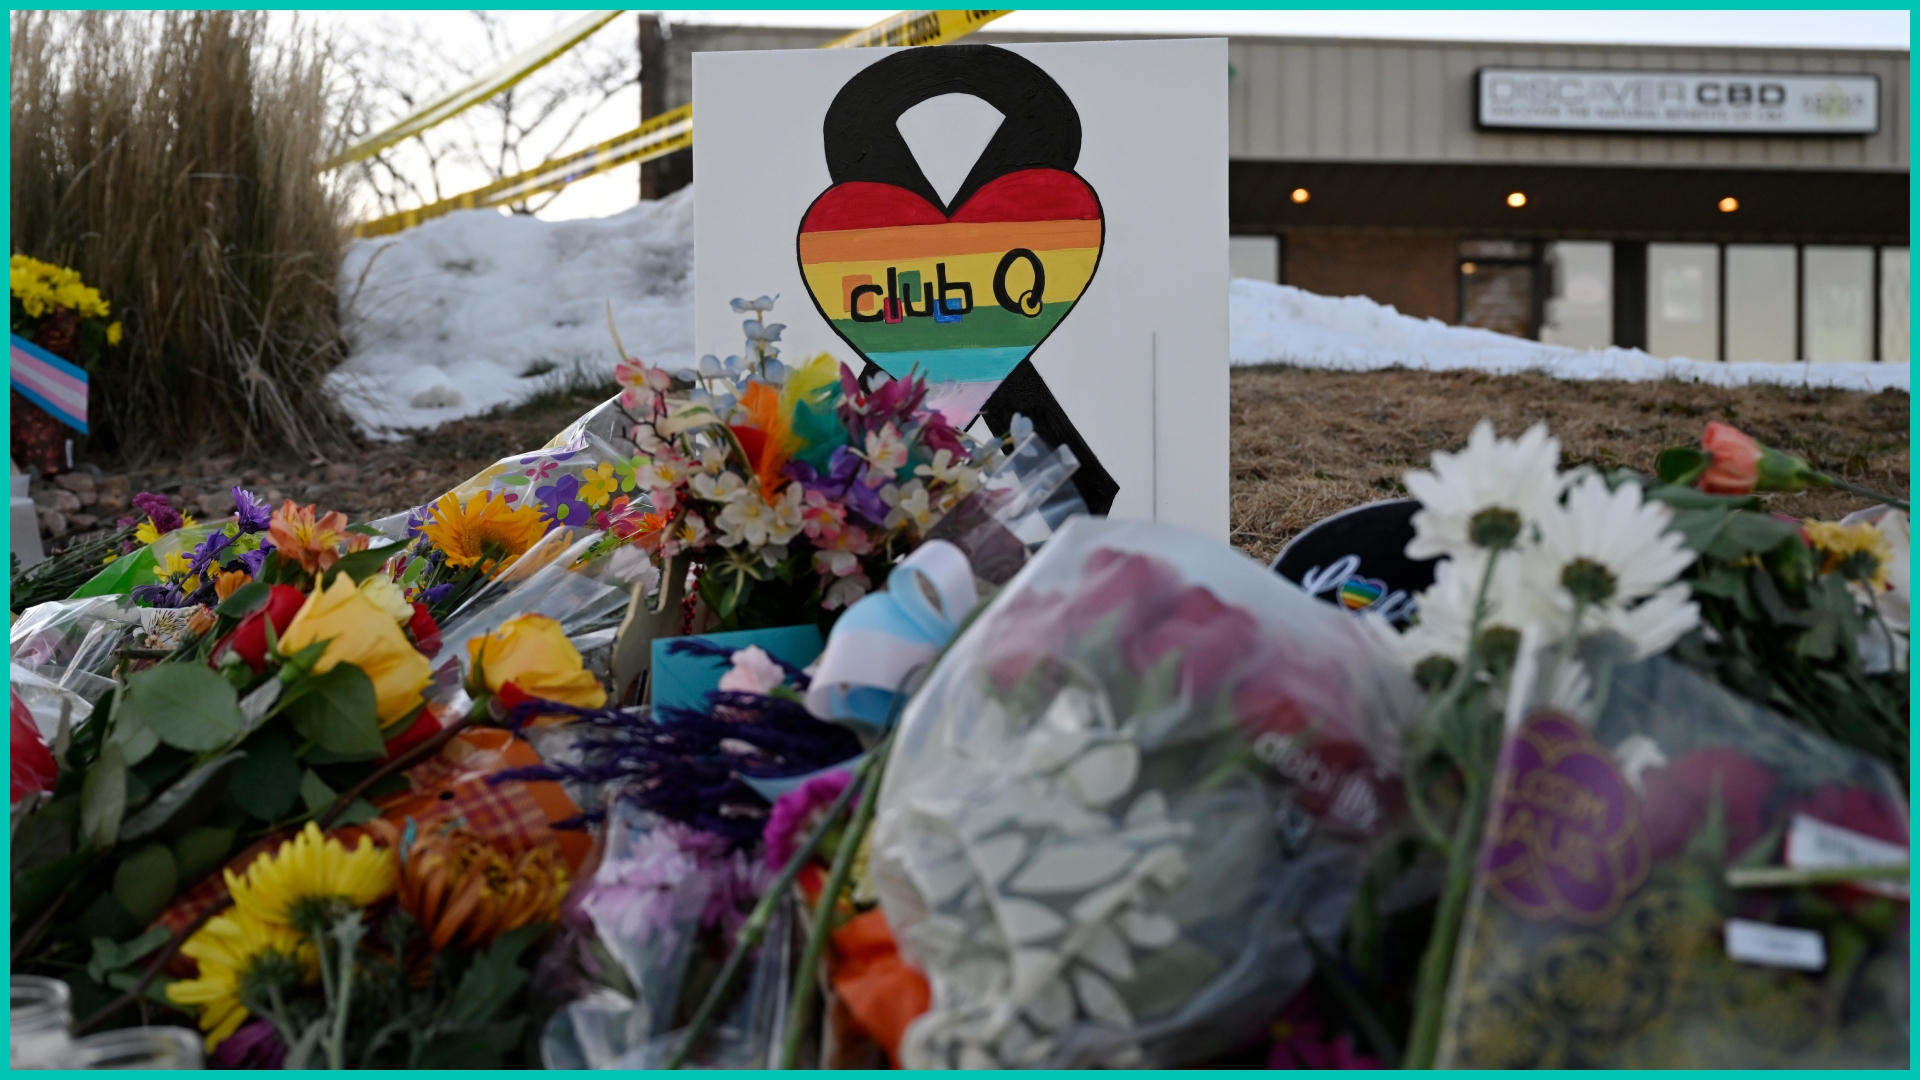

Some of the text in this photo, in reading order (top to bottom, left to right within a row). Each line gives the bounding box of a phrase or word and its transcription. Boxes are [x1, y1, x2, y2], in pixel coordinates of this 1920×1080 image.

[1696, 82, 1786, 107] CBD
[850, 247, 1046, 323] club Q
